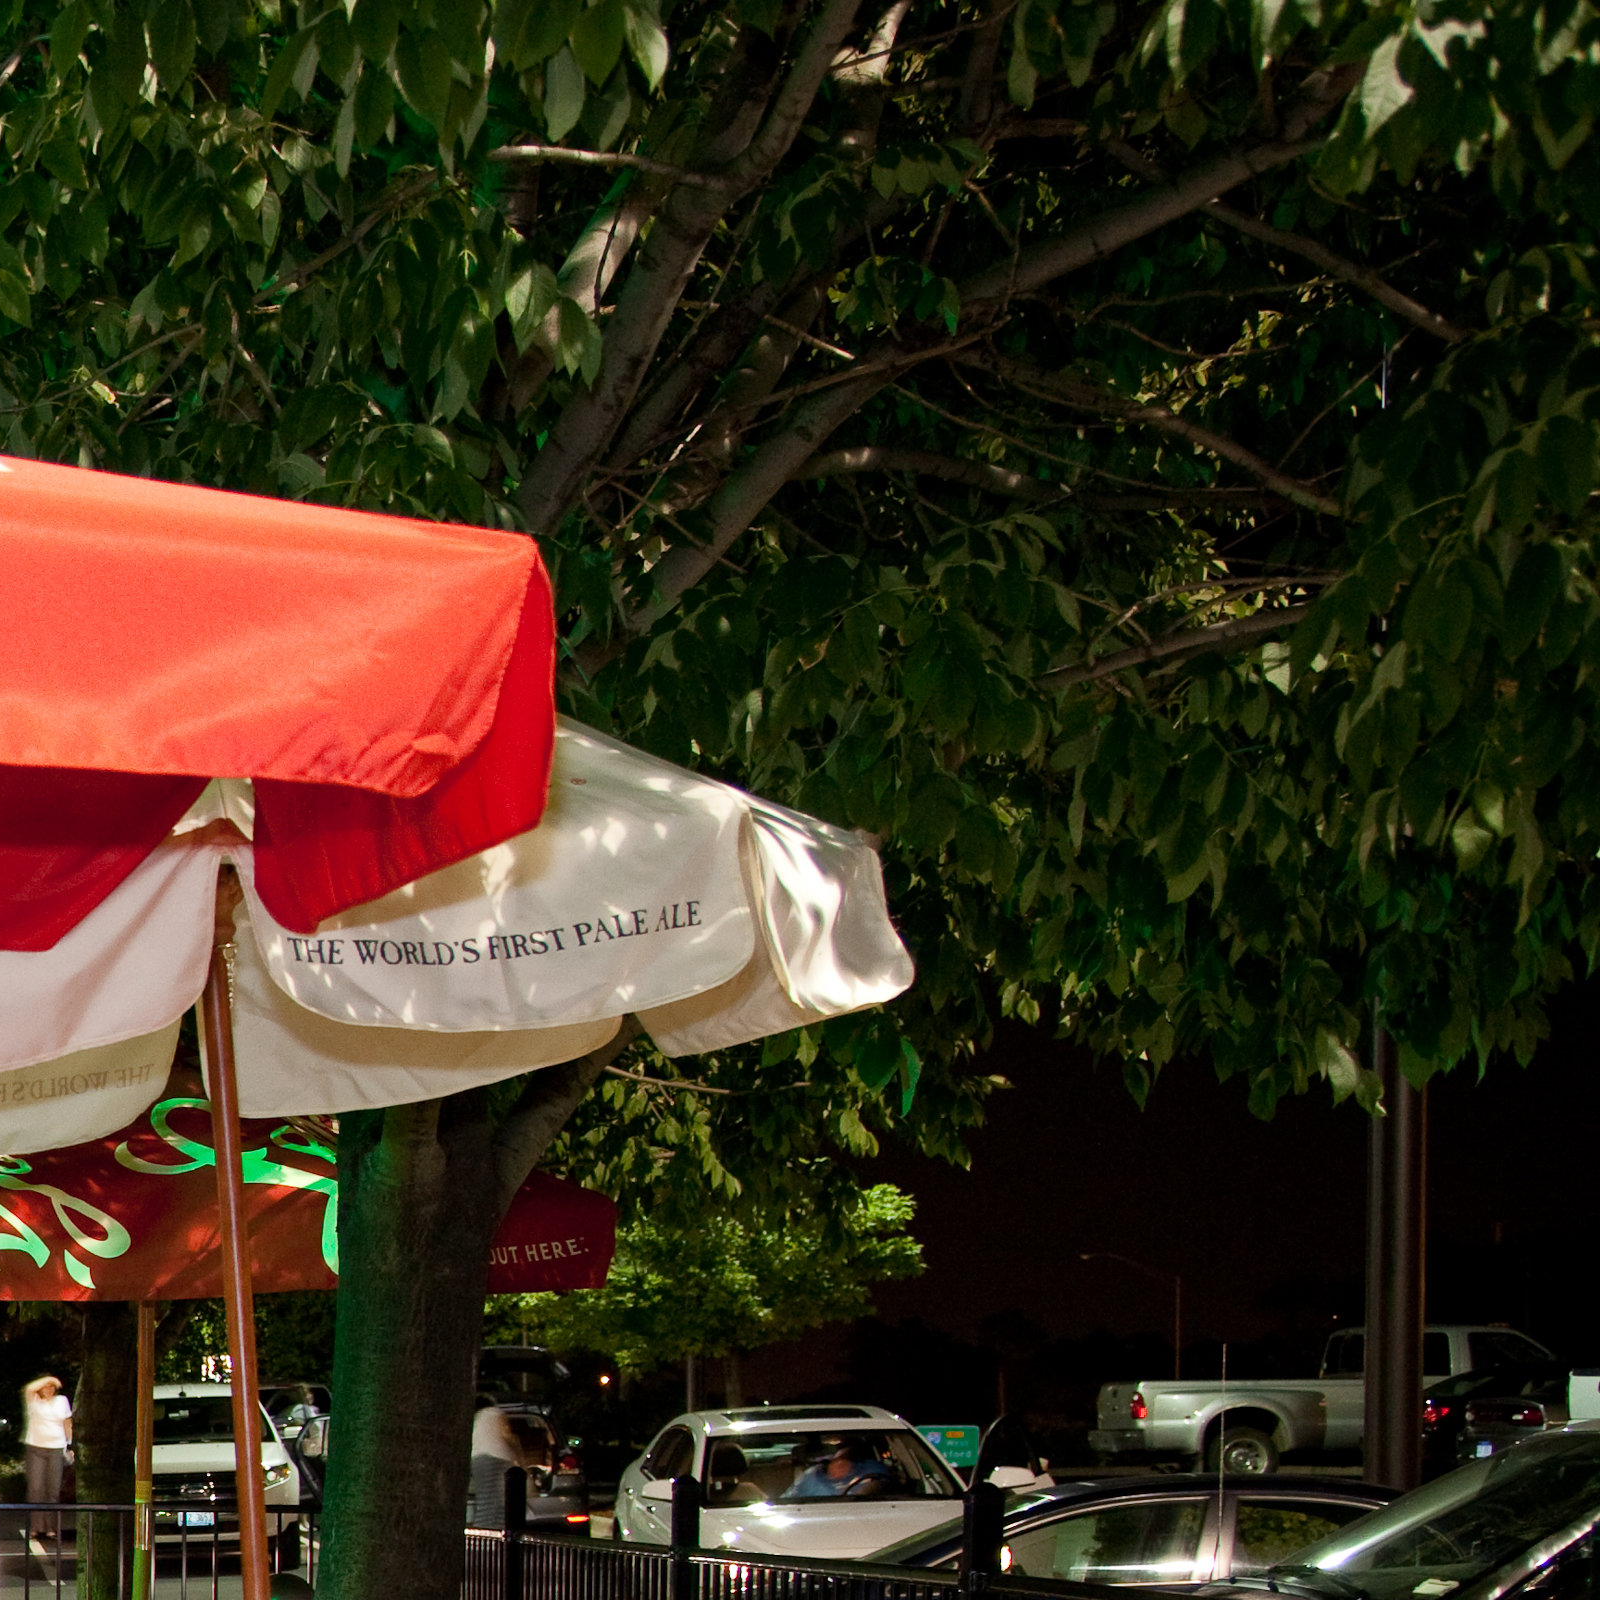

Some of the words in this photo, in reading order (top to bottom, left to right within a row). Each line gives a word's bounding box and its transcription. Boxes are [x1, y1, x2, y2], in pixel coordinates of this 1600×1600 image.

[287, 936, 344, 966] THE
[352, 936, 481, 967] WORLD'S
[487, 927, 566, 961] FIRST
[572, 908, 649, 947] PALE
[654, 900, 703, 933] ALE
